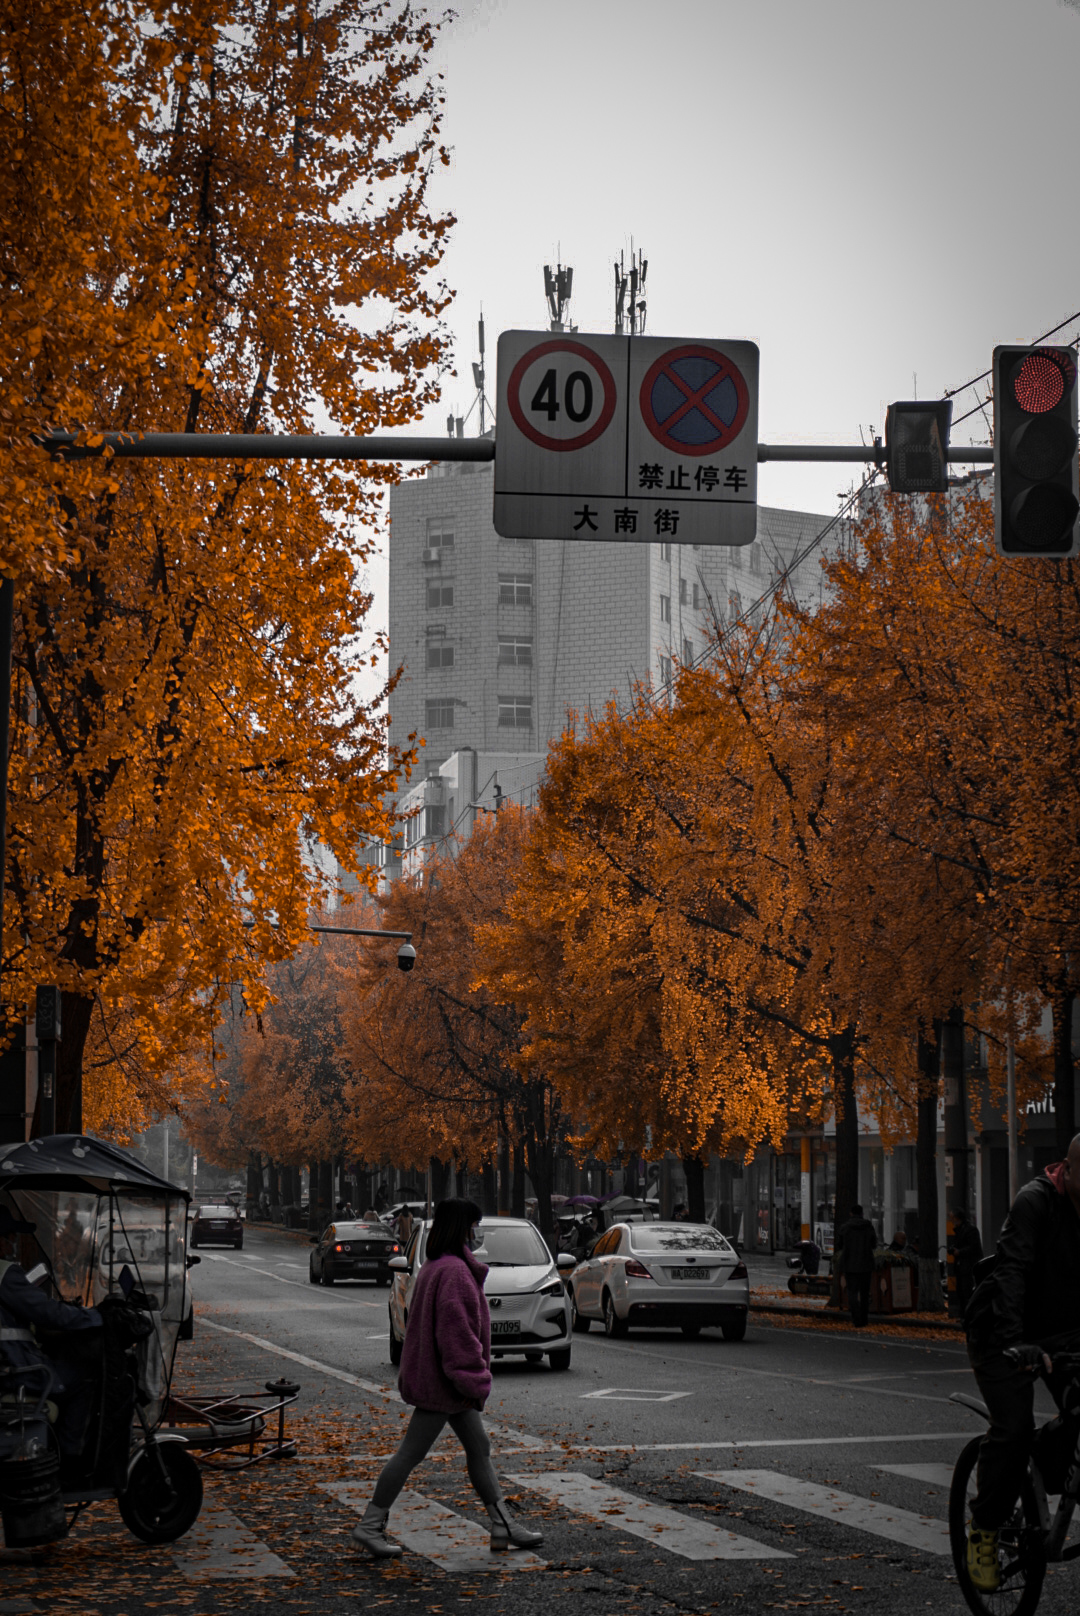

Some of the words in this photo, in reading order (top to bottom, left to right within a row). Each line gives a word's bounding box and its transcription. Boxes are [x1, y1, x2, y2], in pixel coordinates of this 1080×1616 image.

[531, 368, 593, 422] 40
[638, 463, 748, 493] 禁止停车
[573, 504, 680, 536] 大南街
